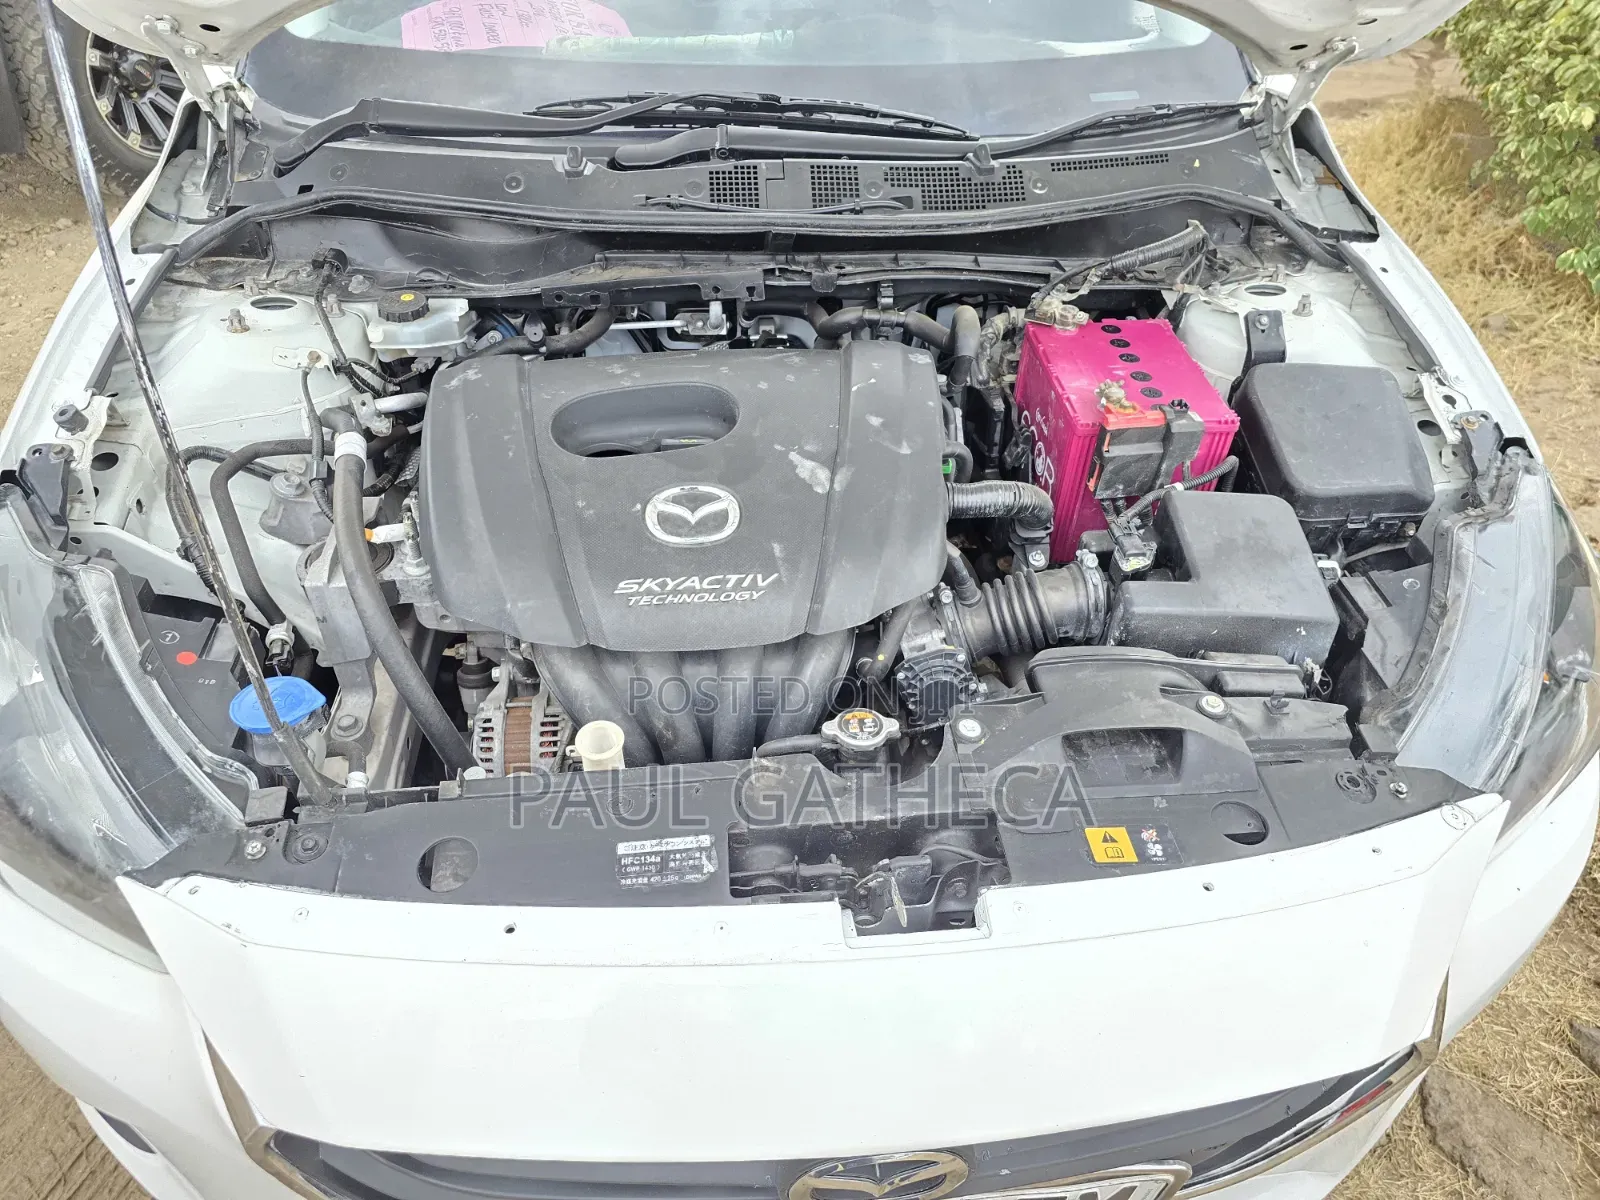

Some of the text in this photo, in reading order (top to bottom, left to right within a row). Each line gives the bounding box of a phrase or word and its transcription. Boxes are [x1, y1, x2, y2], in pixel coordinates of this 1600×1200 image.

[613, 573, 779, 594] SKYACTIV
[627, 590, 766, 606] TECHNOLOGY
[621, 855, 661, 866] HFC134a
